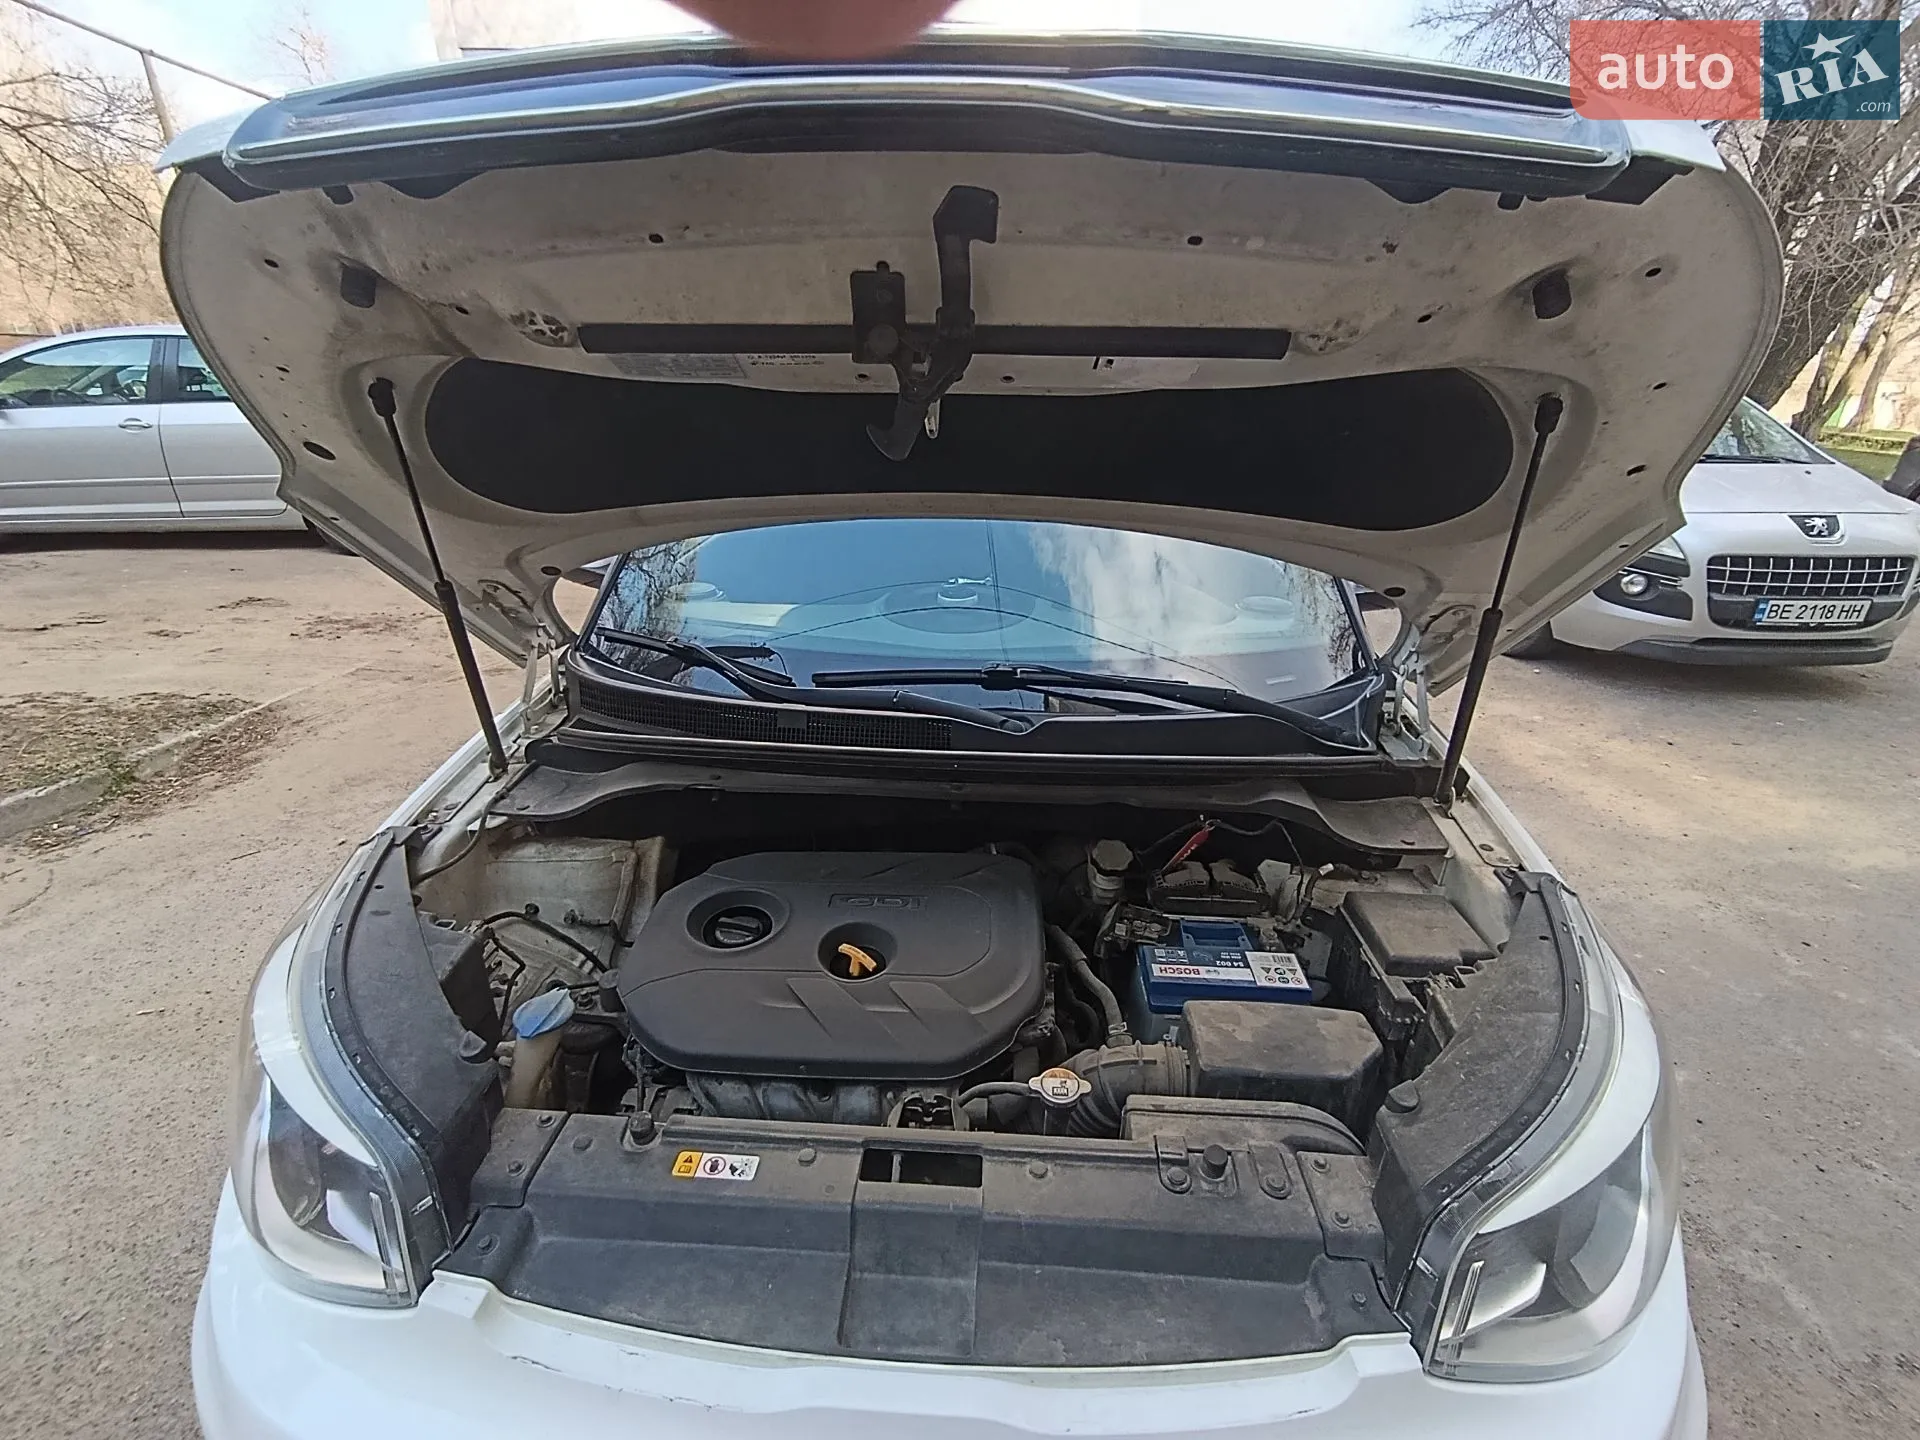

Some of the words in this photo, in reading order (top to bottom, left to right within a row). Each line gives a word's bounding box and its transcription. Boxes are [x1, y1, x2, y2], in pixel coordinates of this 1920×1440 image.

[1767, 604, 1794, 619] BE
[1795, 604, 1836, 619] 2118
[1837, 604, 1864, 619] HH
[1160, 966, 1200, 976] BOSCH
